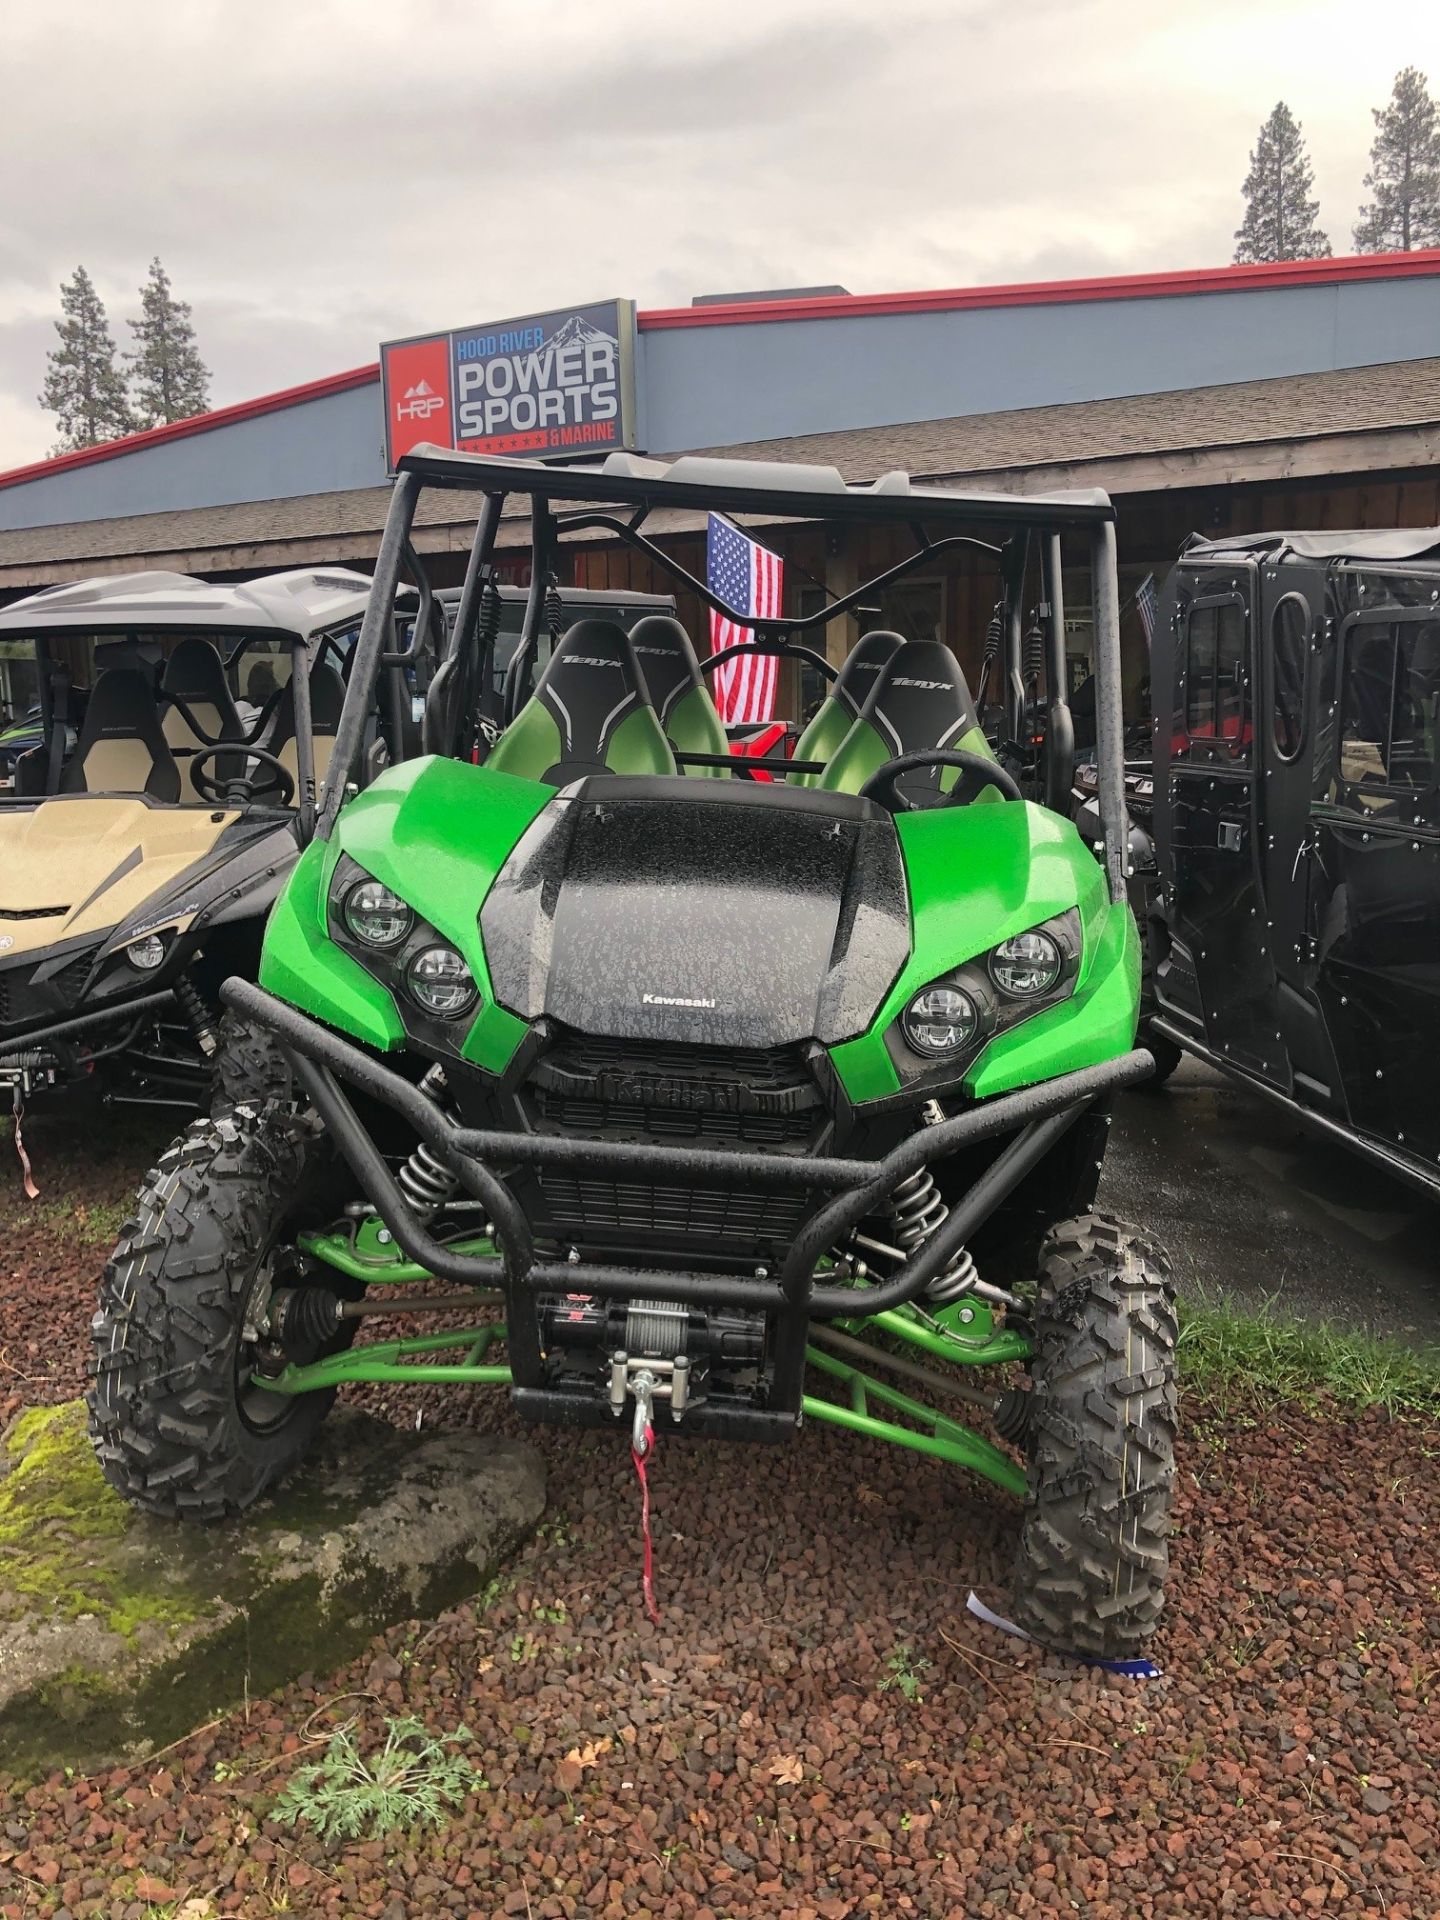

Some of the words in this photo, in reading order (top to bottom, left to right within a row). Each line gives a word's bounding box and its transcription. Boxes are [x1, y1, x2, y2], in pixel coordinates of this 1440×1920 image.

[457, 335, 497, 361] HOOD
[499, 327, 544, 354] RIVER
[458, 340, 615, 402] POWER
[396, 397, 445, 422] HRP
[459, 381, 618, 438] SPORTS
[561, 421, 616, 445] MARINE
[642, 993, 716, 1009] Kawasaki
